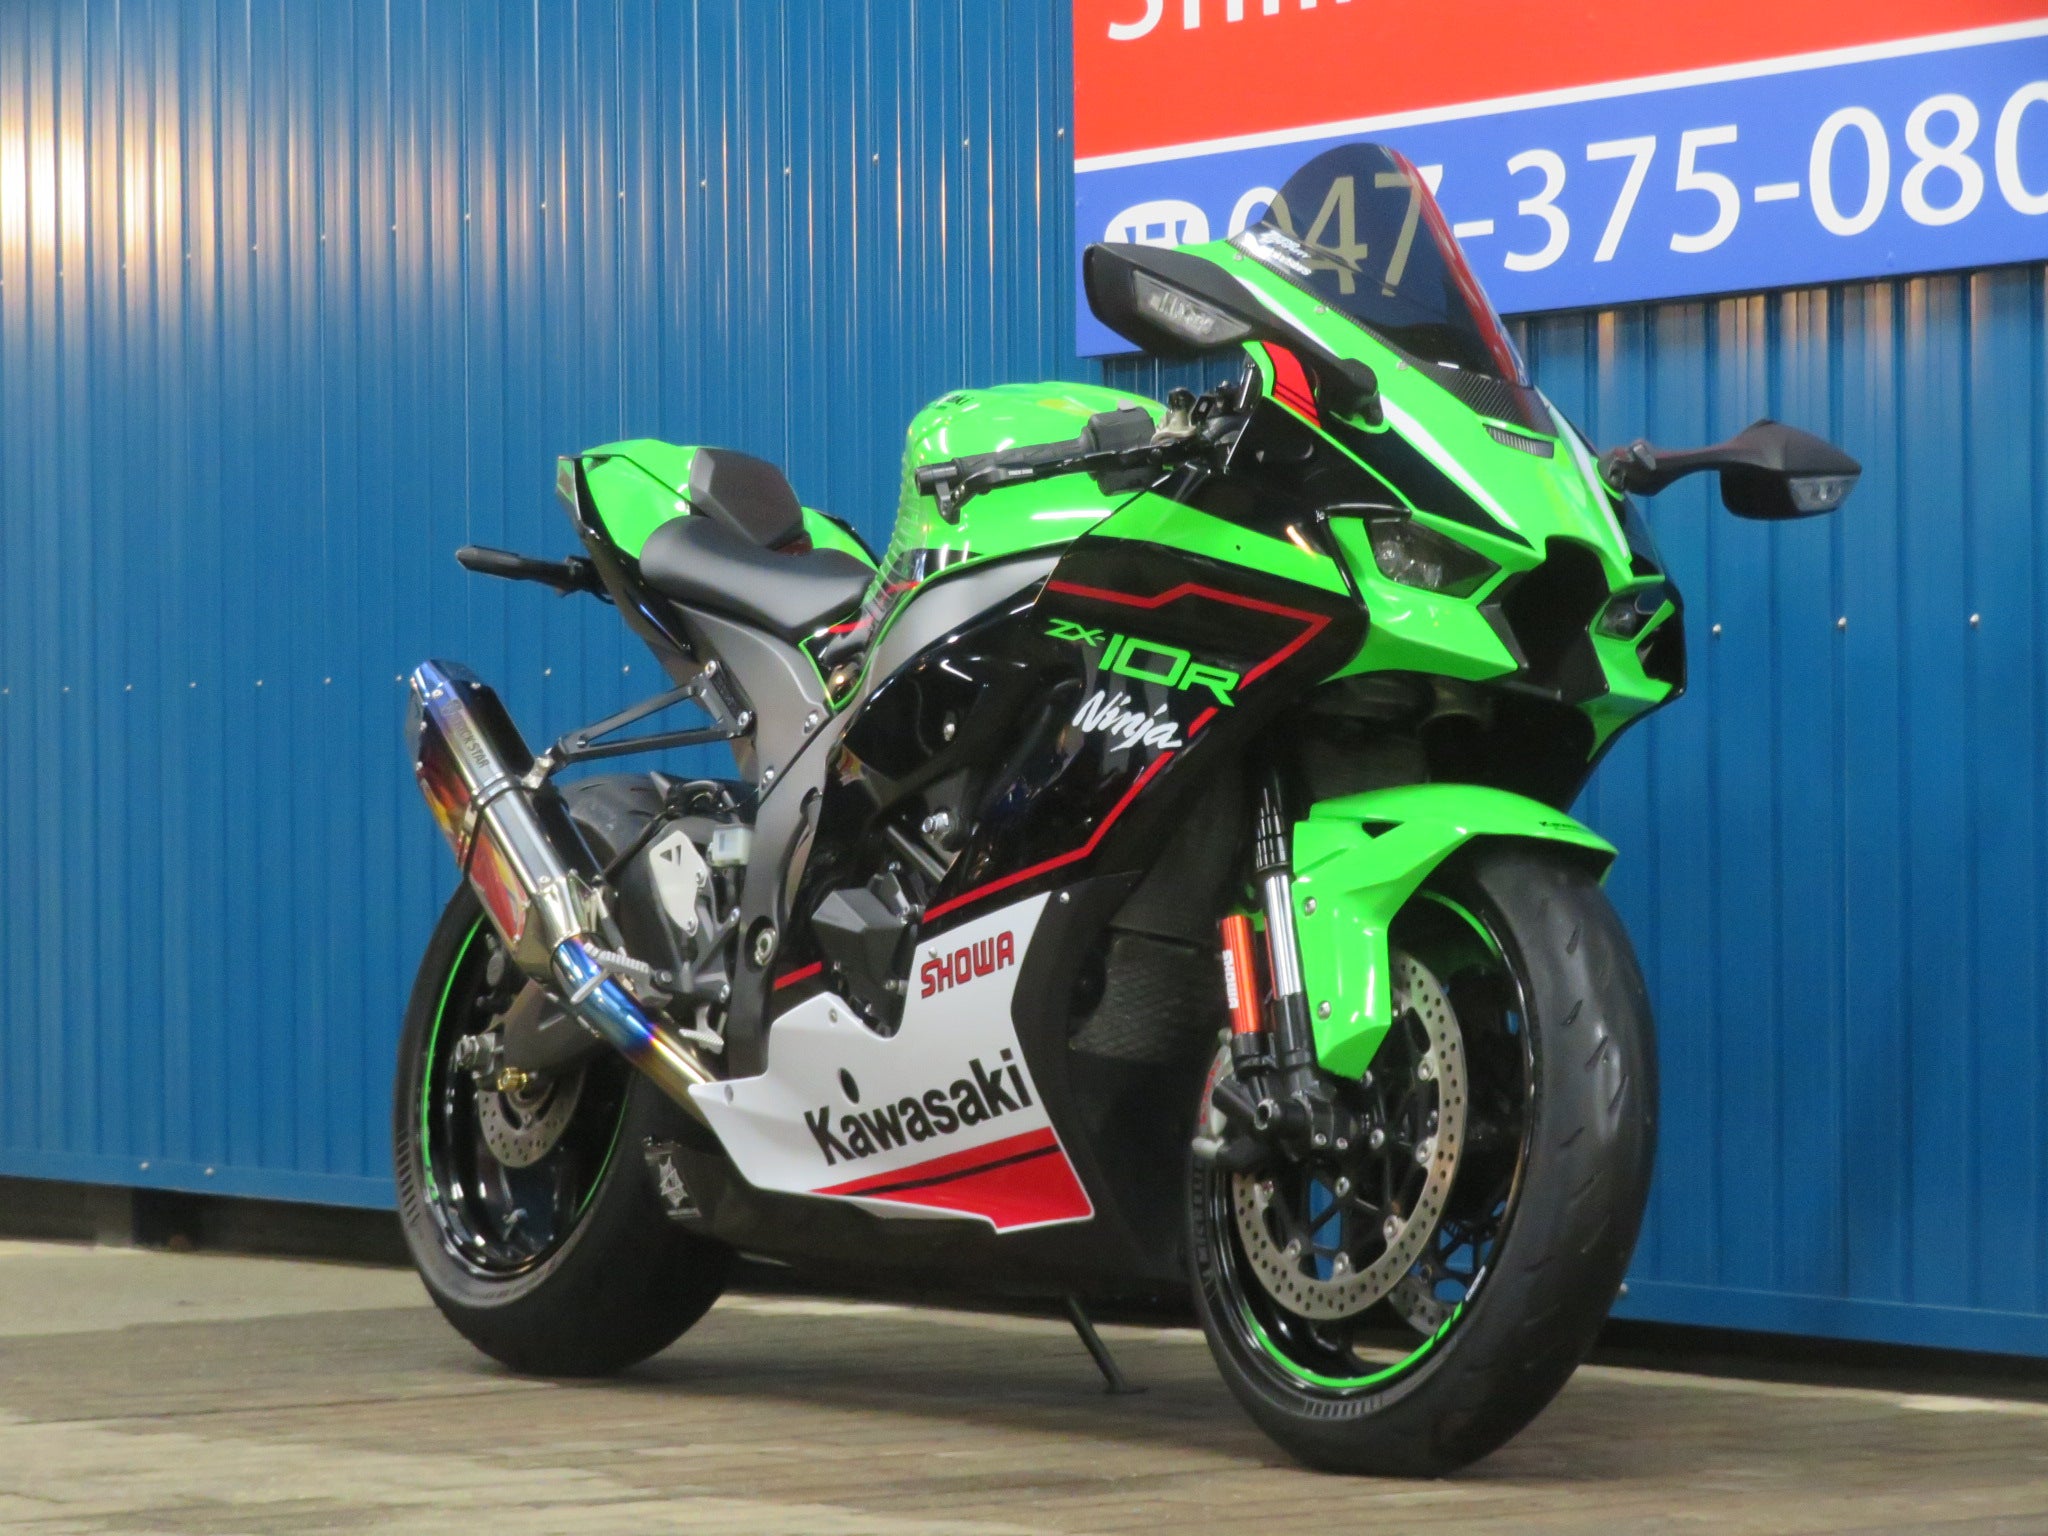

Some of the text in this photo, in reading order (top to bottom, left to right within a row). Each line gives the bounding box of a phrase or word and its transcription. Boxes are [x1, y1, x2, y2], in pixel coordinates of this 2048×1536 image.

[1071, 689, 1183, 752] Ninja
[467, 742, 490, 769] STAR
[920, 930, 1015, 999] SHOWA
[803, 1048, 1034, 1166] Kawasaki
